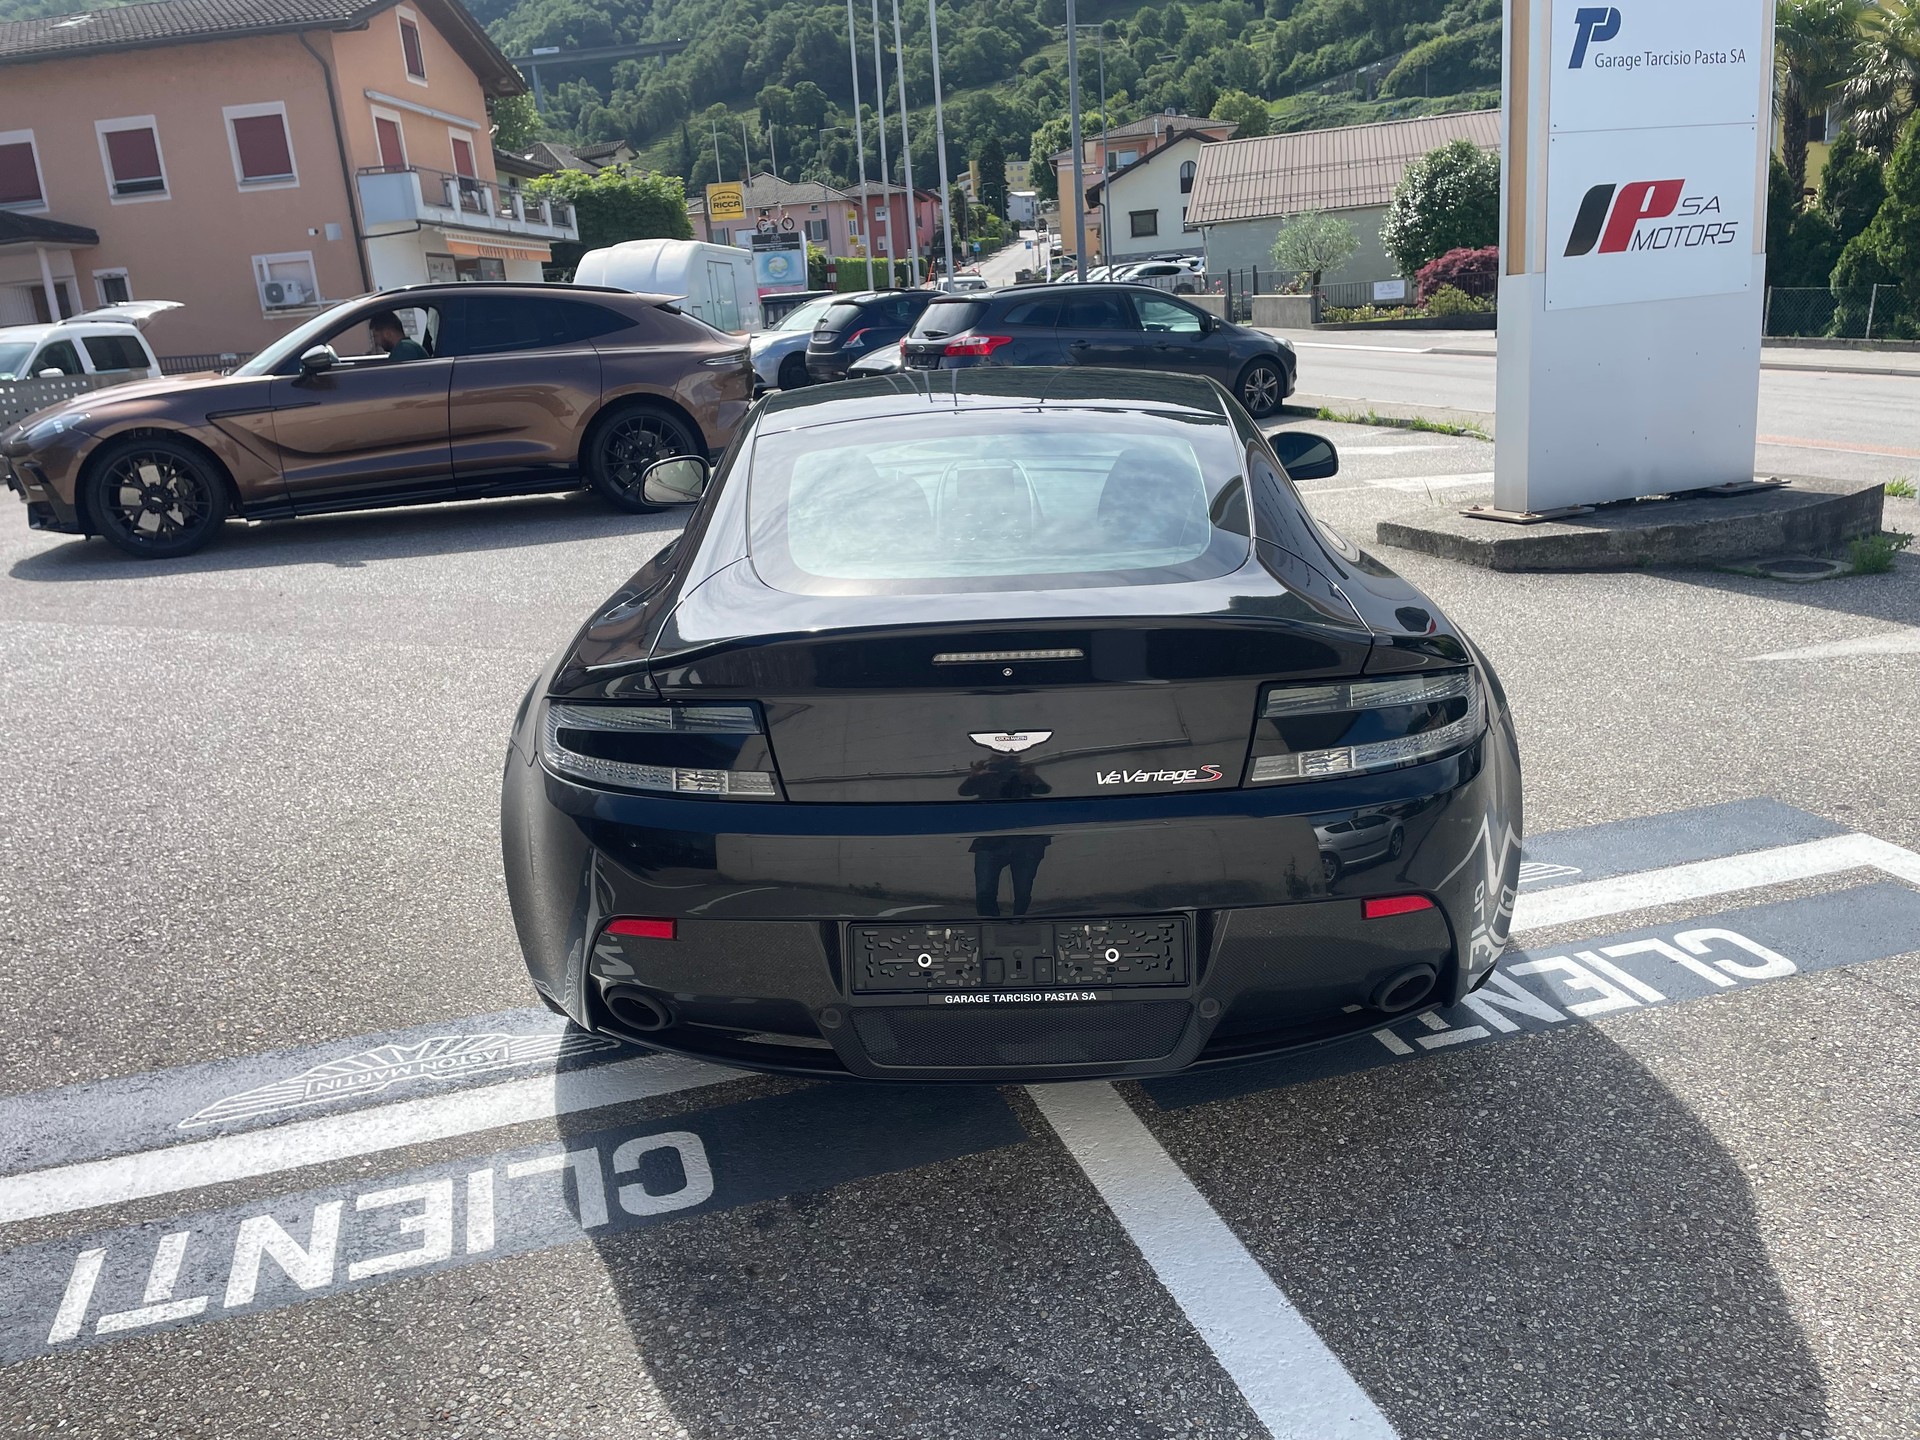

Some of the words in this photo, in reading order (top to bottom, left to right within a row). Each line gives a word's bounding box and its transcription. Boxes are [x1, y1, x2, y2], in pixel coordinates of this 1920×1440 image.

[1594, 53, 1642, 71] Garage
[1644, 50, 1691, 66] Tarcisio
[1694, 49, 1727, 65] Pasta
[1730, 48, 1746, 63] SA
[713, 201, 741, 209] RICCA
[1677, 196, 1721, 216] SA
[1631, 221, 1739, 252] MOTORS
[1122, 764, 1198, 785] Vantage
[944, 994, 990, 1004] GARAGE
[992, 993, 1042, 1003] TARCISIO
[1044, 992, 1079, 1002] PASTA
[1081, 991, 1097, 1001] SA
[420, 1049, 499, 1073] ASTON
[317, 1064, 412, 1092] MARTIN
[46, 1130, 714, 1346] CLIENTI
